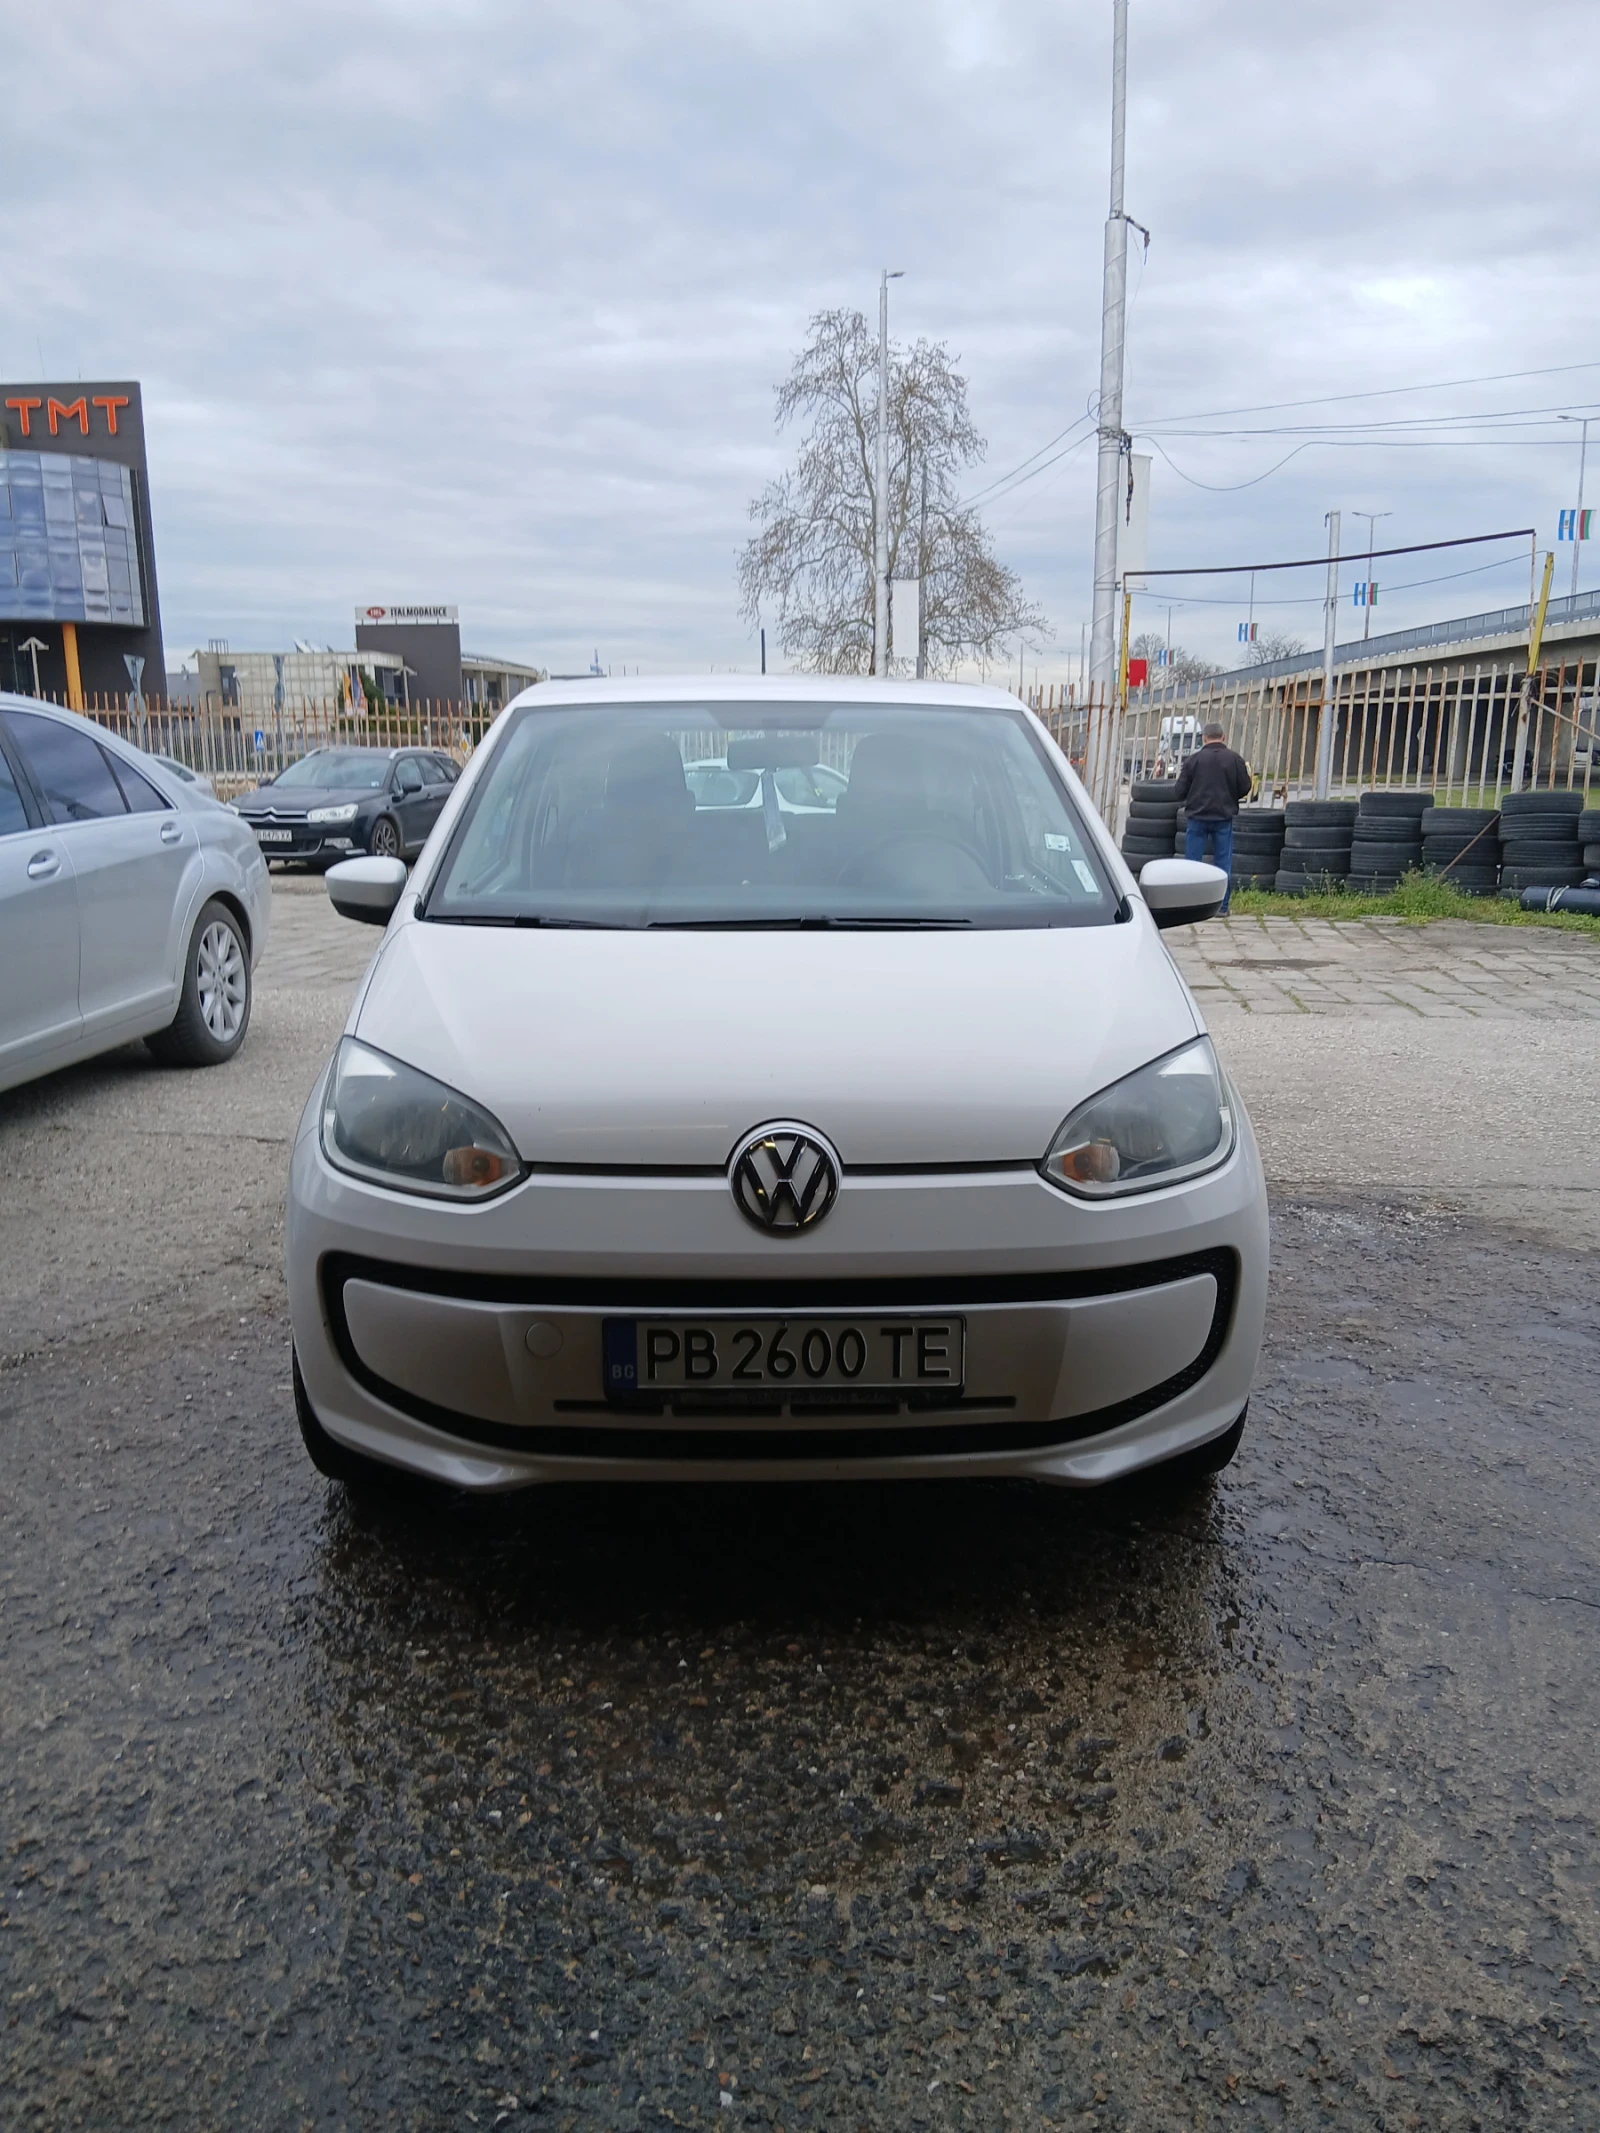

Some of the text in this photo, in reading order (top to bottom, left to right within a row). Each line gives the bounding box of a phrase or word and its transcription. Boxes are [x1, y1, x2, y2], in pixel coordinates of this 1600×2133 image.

[5, 396, 128, 435] TMT
[390, 606, 447, 618] ITALMODALUCE
[738, 1131, 834, 1227] VW
[612, 1327, 951, 1381] BG PB 2600 TE
